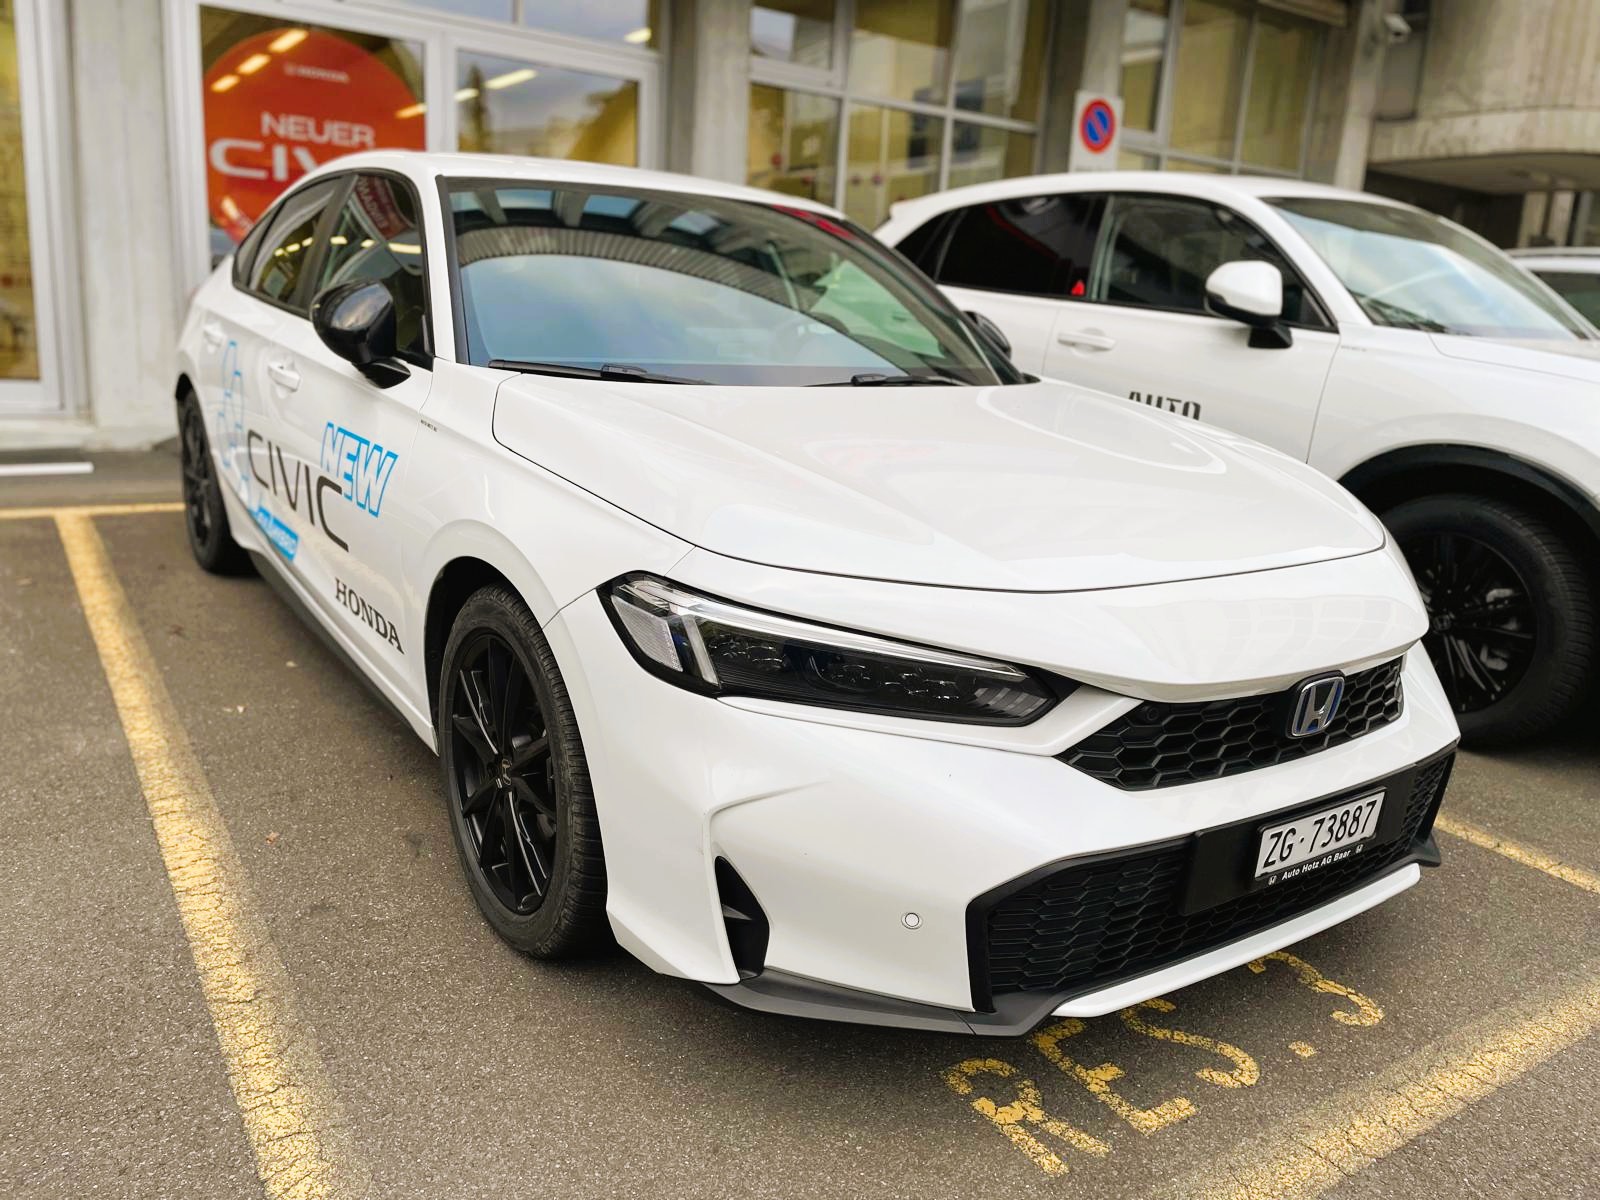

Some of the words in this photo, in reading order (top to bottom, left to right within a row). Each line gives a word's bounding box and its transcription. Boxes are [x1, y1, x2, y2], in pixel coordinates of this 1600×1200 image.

[261, 111, 375, 148] NEUER
[247, 428, 350, 553] CIVIC
[320, 422, 399, 518] NEW
[335, 577, 405, 655] HONDA
[1281, 868, 1300, 880] Auto
[1301, 861, 1320, 873] Hotz
[1320, 855, 1333, 867] AG
[1333, 850, 1352, 862] Baar
